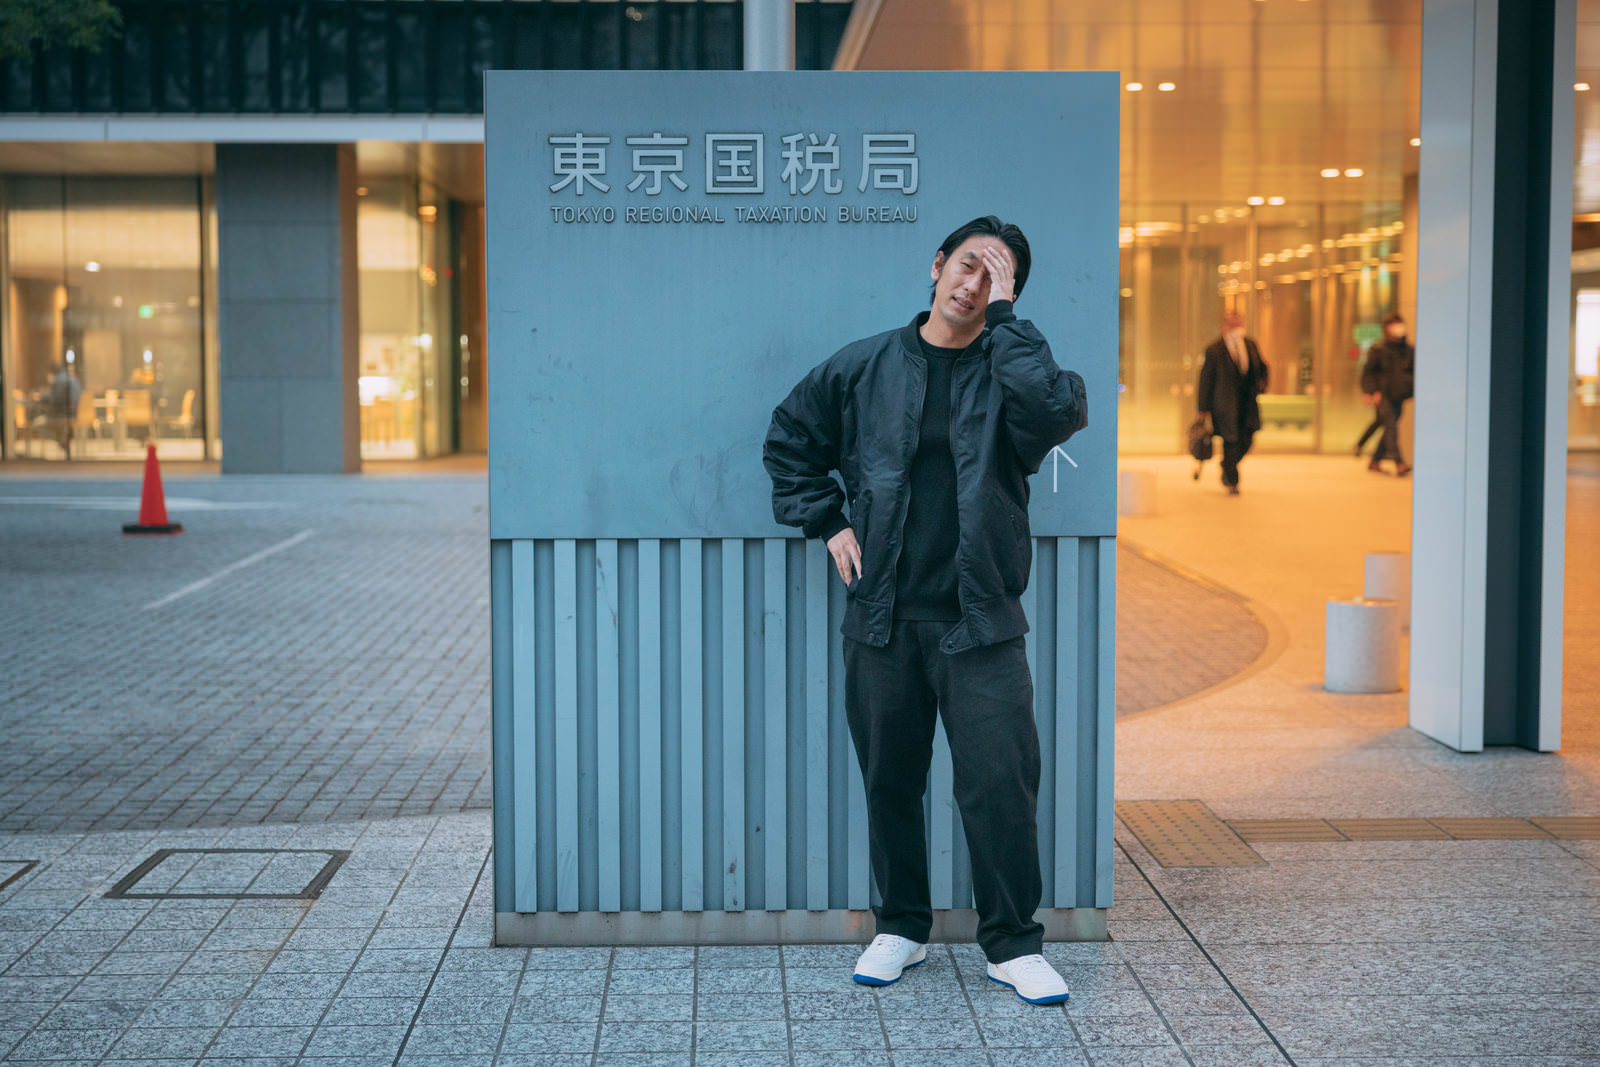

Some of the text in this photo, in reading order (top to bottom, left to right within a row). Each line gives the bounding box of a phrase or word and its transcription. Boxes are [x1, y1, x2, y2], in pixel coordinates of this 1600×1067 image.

[548, 132, 919, 195] 東京国税局
[551, 206, 919, 223] TOKYO REGIONAL TAXATION BUREAU
